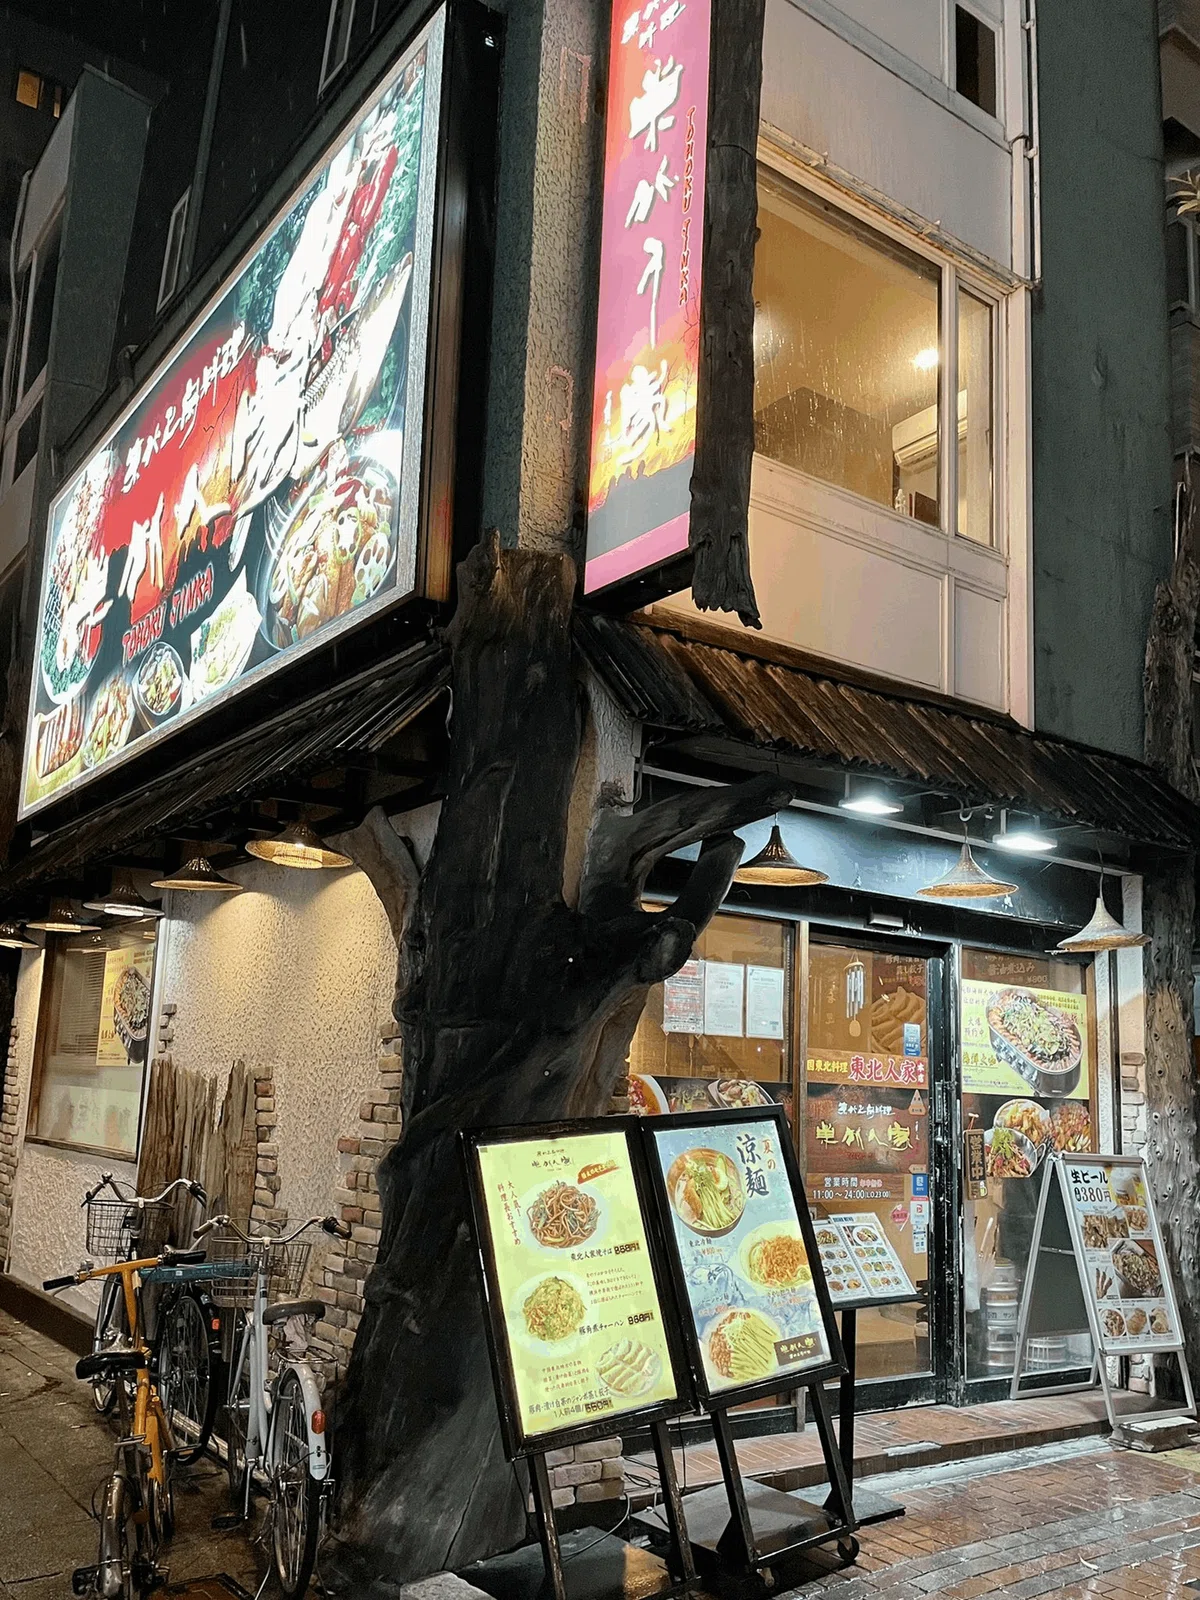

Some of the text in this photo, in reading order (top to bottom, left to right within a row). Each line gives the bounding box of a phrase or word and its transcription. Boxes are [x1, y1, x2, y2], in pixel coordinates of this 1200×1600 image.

[679, 107, 695, 305] TOHOKU JINKA
[122, 562, 214, 662] TOHOKU JINKA
[848, 1054, 918, 1085] 東北人家
[917, 1062, 925, 1083] 本店
[760, 1138, 777, 1171] 夏の
[970, 1134, 984, 1180] 営業中
[824, 1176, 858, 1188] 営業時間
[1071, 1169, 1109, 1185] 生ビール
